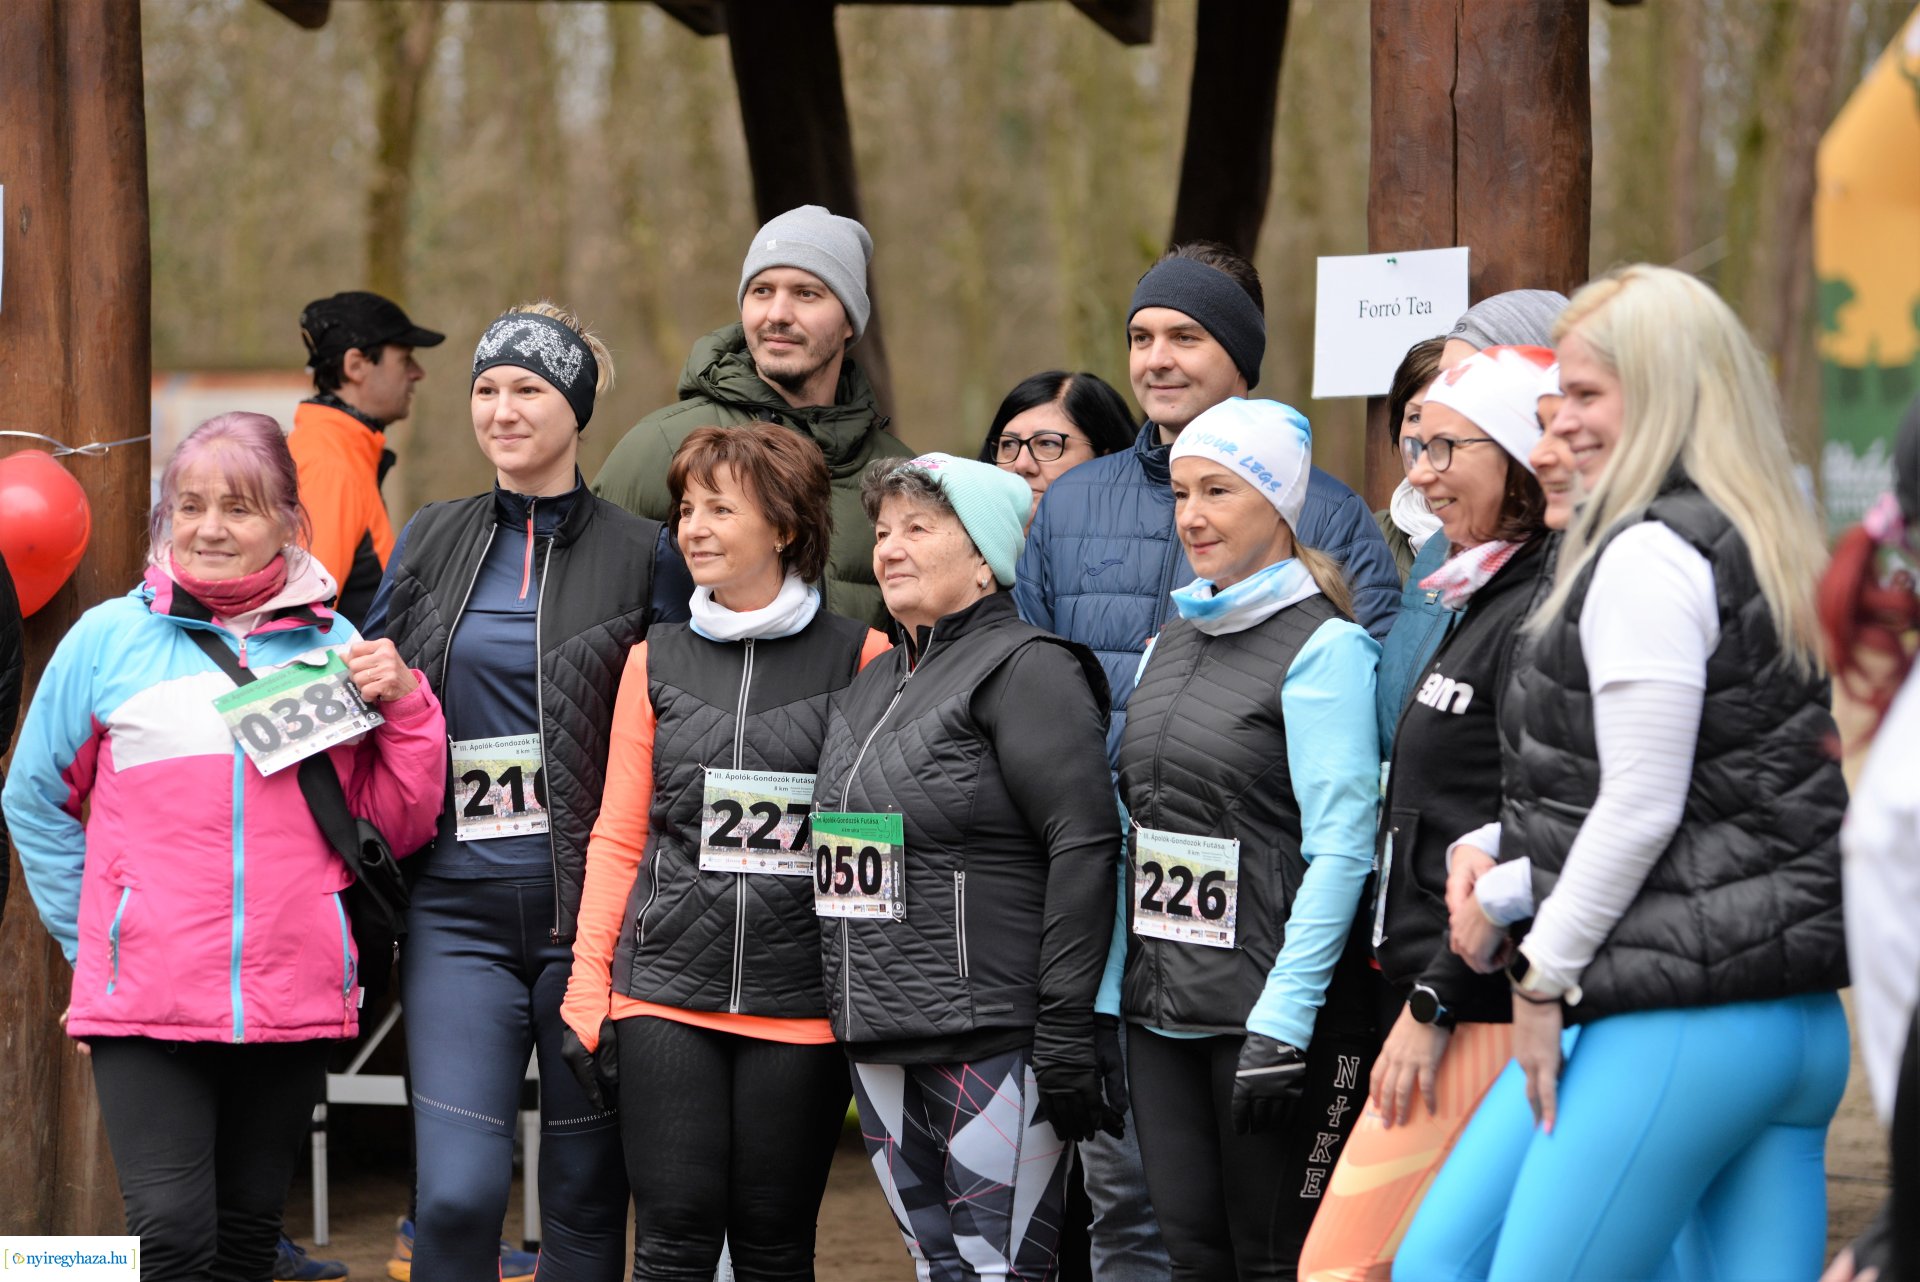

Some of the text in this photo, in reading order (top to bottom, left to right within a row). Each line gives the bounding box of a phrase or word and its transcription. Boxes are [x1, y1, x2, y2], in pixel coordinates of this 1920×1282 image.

[1358, 296, 1432, 319] Forró Tea
[1194, 431, 1239, 456] YOUR
[1239, 455, 1282, 493] LEGS
[240, 683, 347, 753] 038
[725, 772, 790, 783] Ápolók-Gondozók
[791, 776, 815, 785] Futása
[708, 798, 812, 851] 227
[1203, 842, 1225, 850] Futása
[816, 844, 882, 895] 050
[1140, 861, 1227, 920] 226
[1300, 1055, 1360, 1198] NIKE
